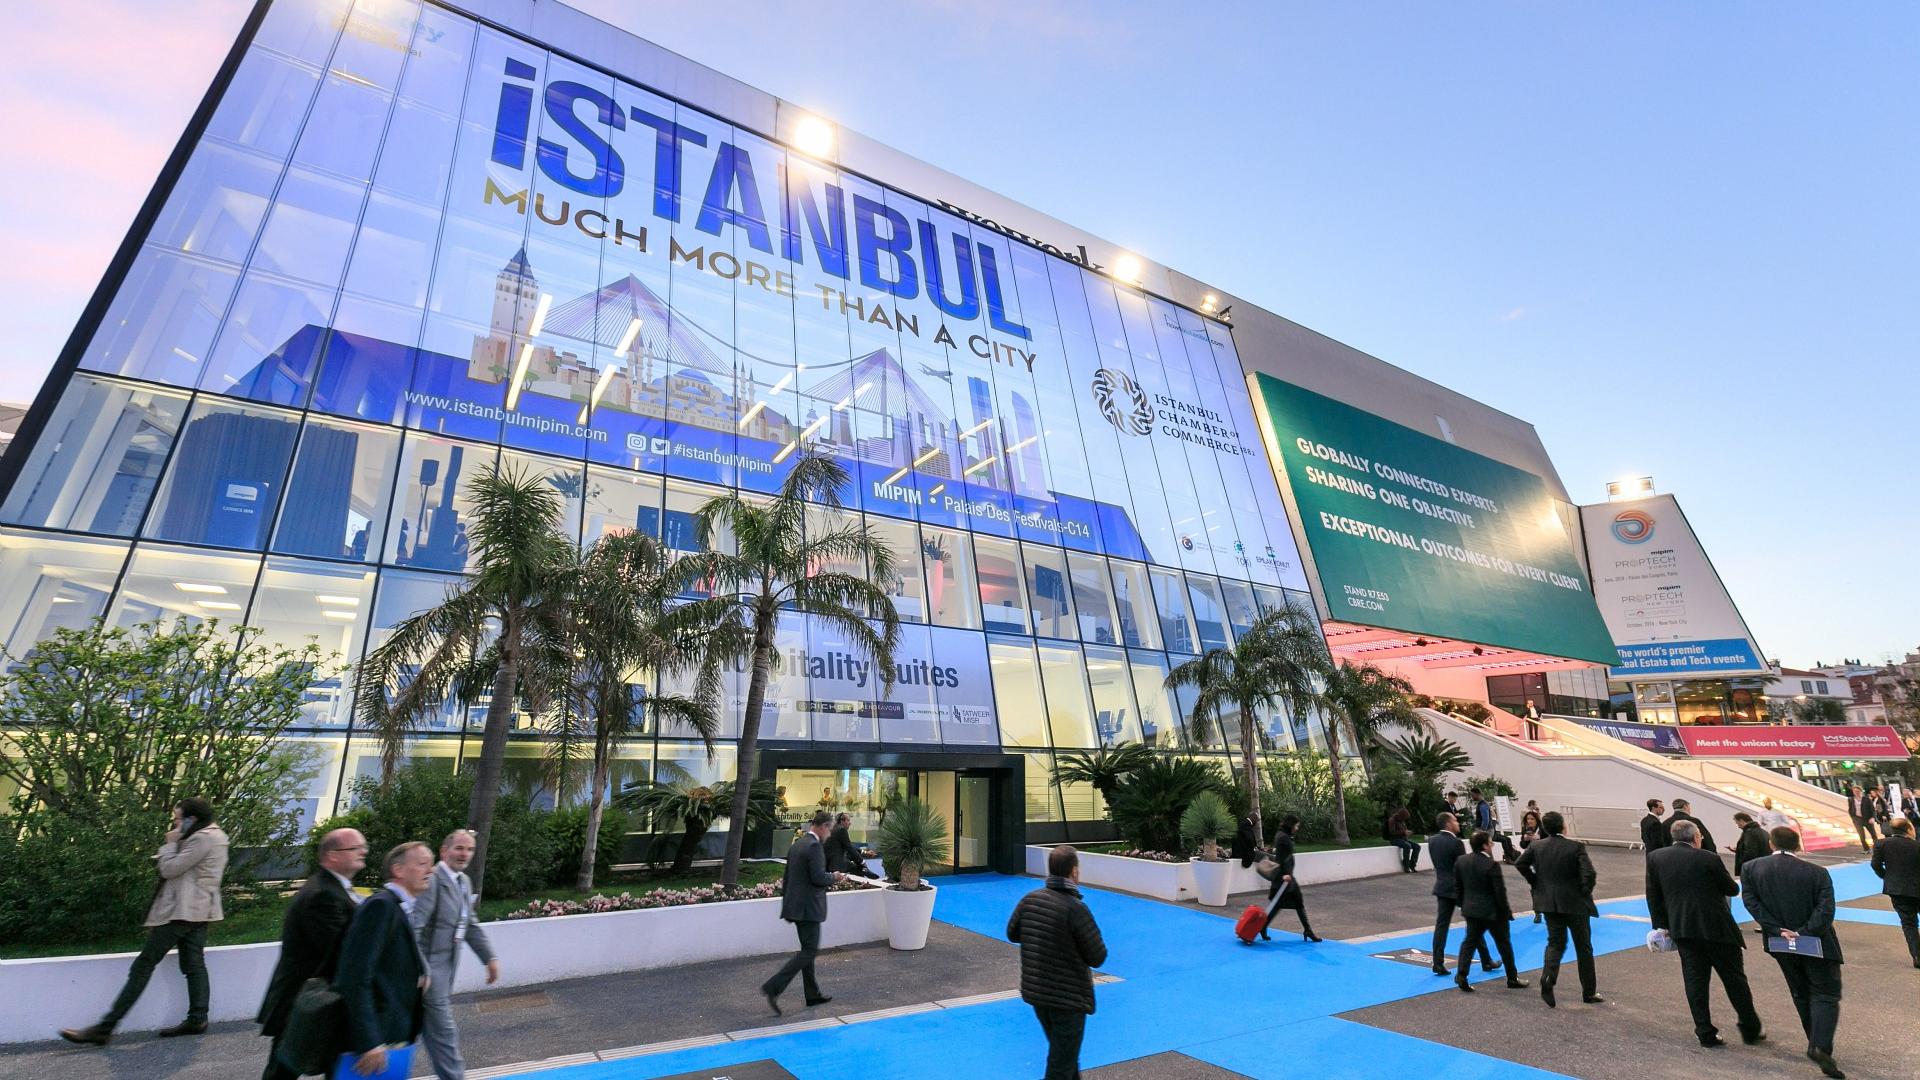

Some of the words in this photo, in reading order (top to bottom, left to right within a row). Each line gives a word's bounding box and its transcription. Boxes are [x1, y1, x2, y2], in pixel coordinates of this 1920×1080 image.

[483, 176, 647, 253] MUCH
[670, 236, 798, 299] MORE
[814, 283, 919, 338] THAN
[934, 324, 957, 349] A
[968, 334, 1036, 373] CITY
[404, 389, 607, 442] www.istanbulmipim.com
[1154, 393, 1222, 423] ISTANBUL
[1158, 409, 1230, 439] CHAMBER
[1162, 425, 1239, 456] COMMERCE
[672, 444, 772, 473] #istanbulMipim
[1296, 437, 1370, 473] GLOBALLY
[1374, 462, 1450, 498] CONNECTED
[1451, 490, 1498, 513] EXPERTS
[873, 482, 922, 505] MIPIM
[945, 496, 984, 515] Palais
[985, 504, 1010, 523] Des
[1014, 510, 1090, 538] Festivals-C14
[1305, 465, 1377, 500] SHARING
[1379, 488, 1411, 511] ONE
[1412, 498, 1475, 529] OBJECTIVE
[1320, 511, 1421, 551] EXCEPTIONAL
[1421, 538, 1490, 569] OUTCOMES
[1491, 557, 1516, 575] FOR
[1516, 563, 1549, 583] EVERY
[1550, 572, 1582, 592] CLIENT
[1343, 585, 1367, 597] STAND
[1348, 597, 1384, 612] CBRE.COM
[1617, 649, 1632, 658] The
[1634, 646, 1667, 657] world's
[1669, 645, 1705, 657] premier
[1619, 658, 1638, 669] eal
[1640, 657, 1668, 668] Estate
[1670, 656, 1686, 666] and
[1689, 655, 1711, 666] Tech
[1713, 654, 1745, 665] events
[962, 710, 990, 718] TATWEER
[1696, 739, 1720, 747] Meet
[1722, 738, 1738, 747] the
[1741, 738, 1777, 747] unicorn
[1779, 738, 1816, 749] factory
[1838, 734, 1889, 743] Stockholm
